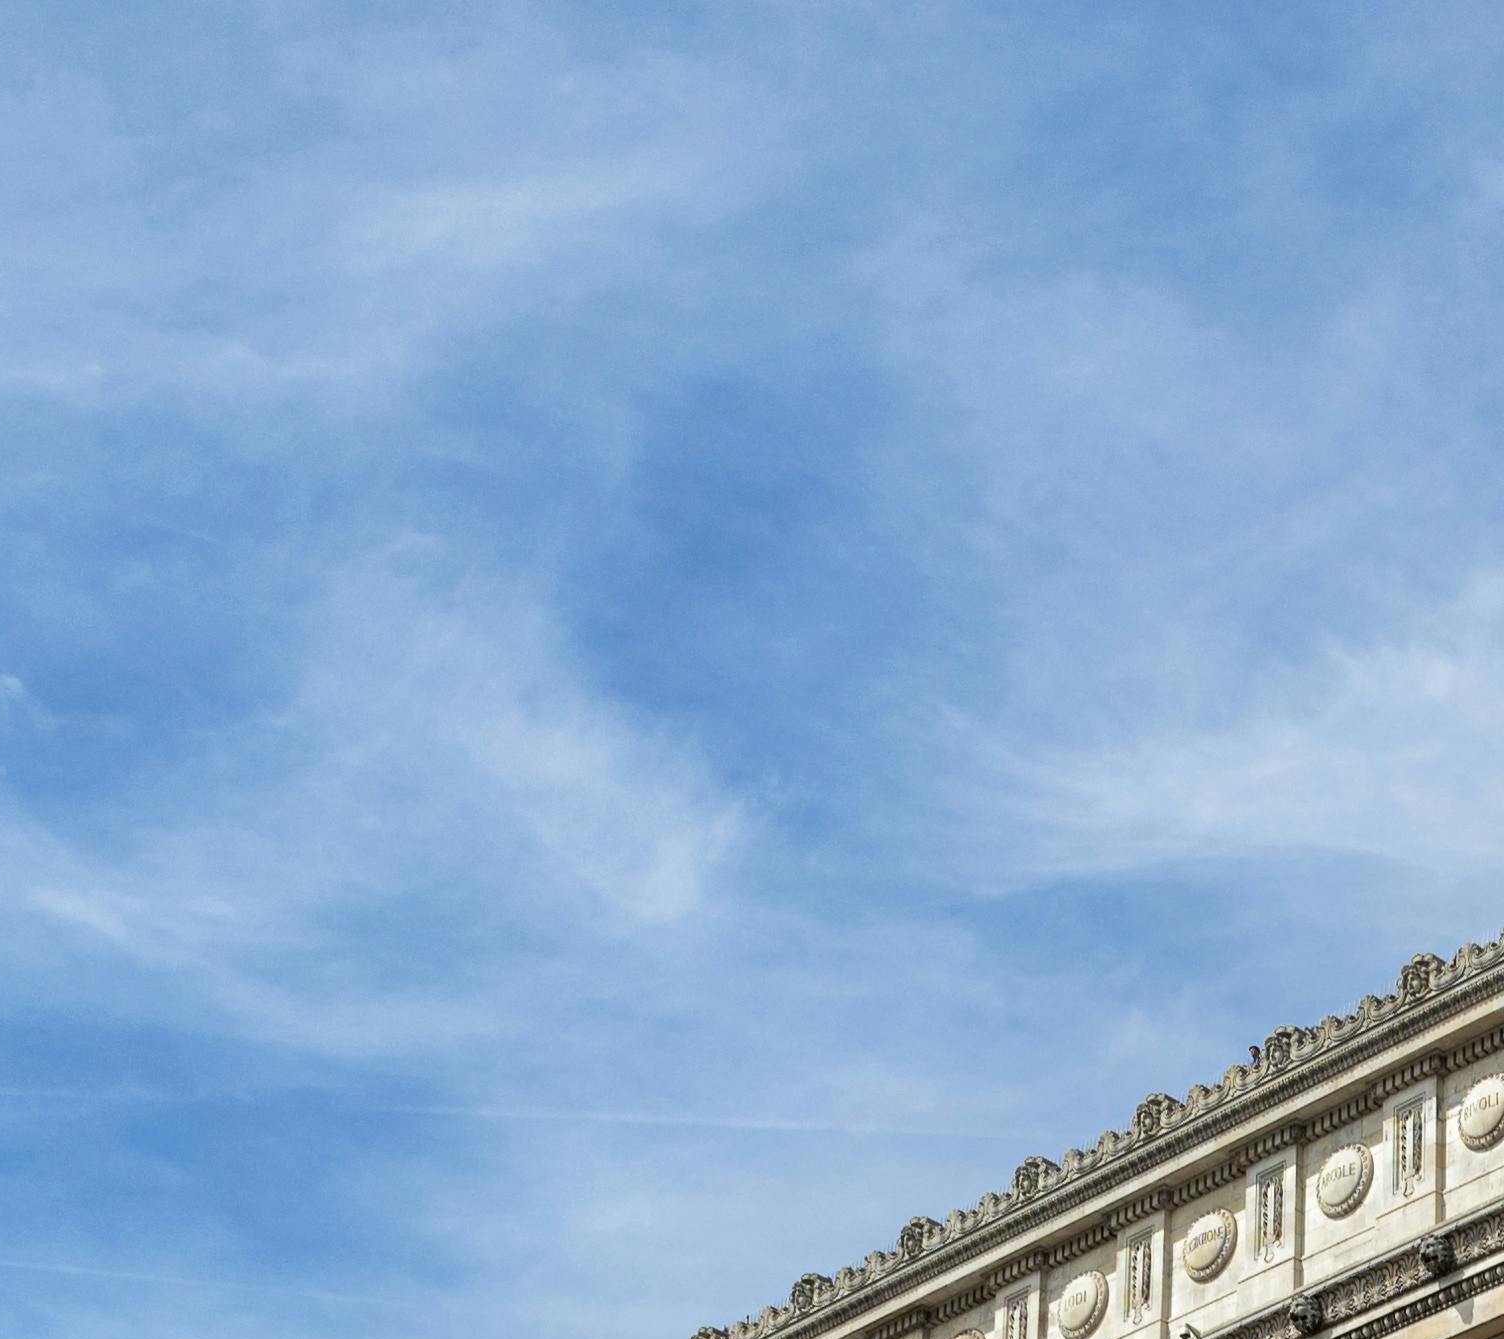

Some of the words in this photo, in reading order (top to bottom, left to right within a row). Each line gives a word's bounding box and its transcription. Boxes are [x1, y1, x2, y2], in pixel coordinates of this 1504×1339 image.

[1463, 1091, 1501, 1121] RIVOLI
[1320, 1162, 1357, 1190] ARCOLE
[1064, 1290, 1087, 1313] LODI
